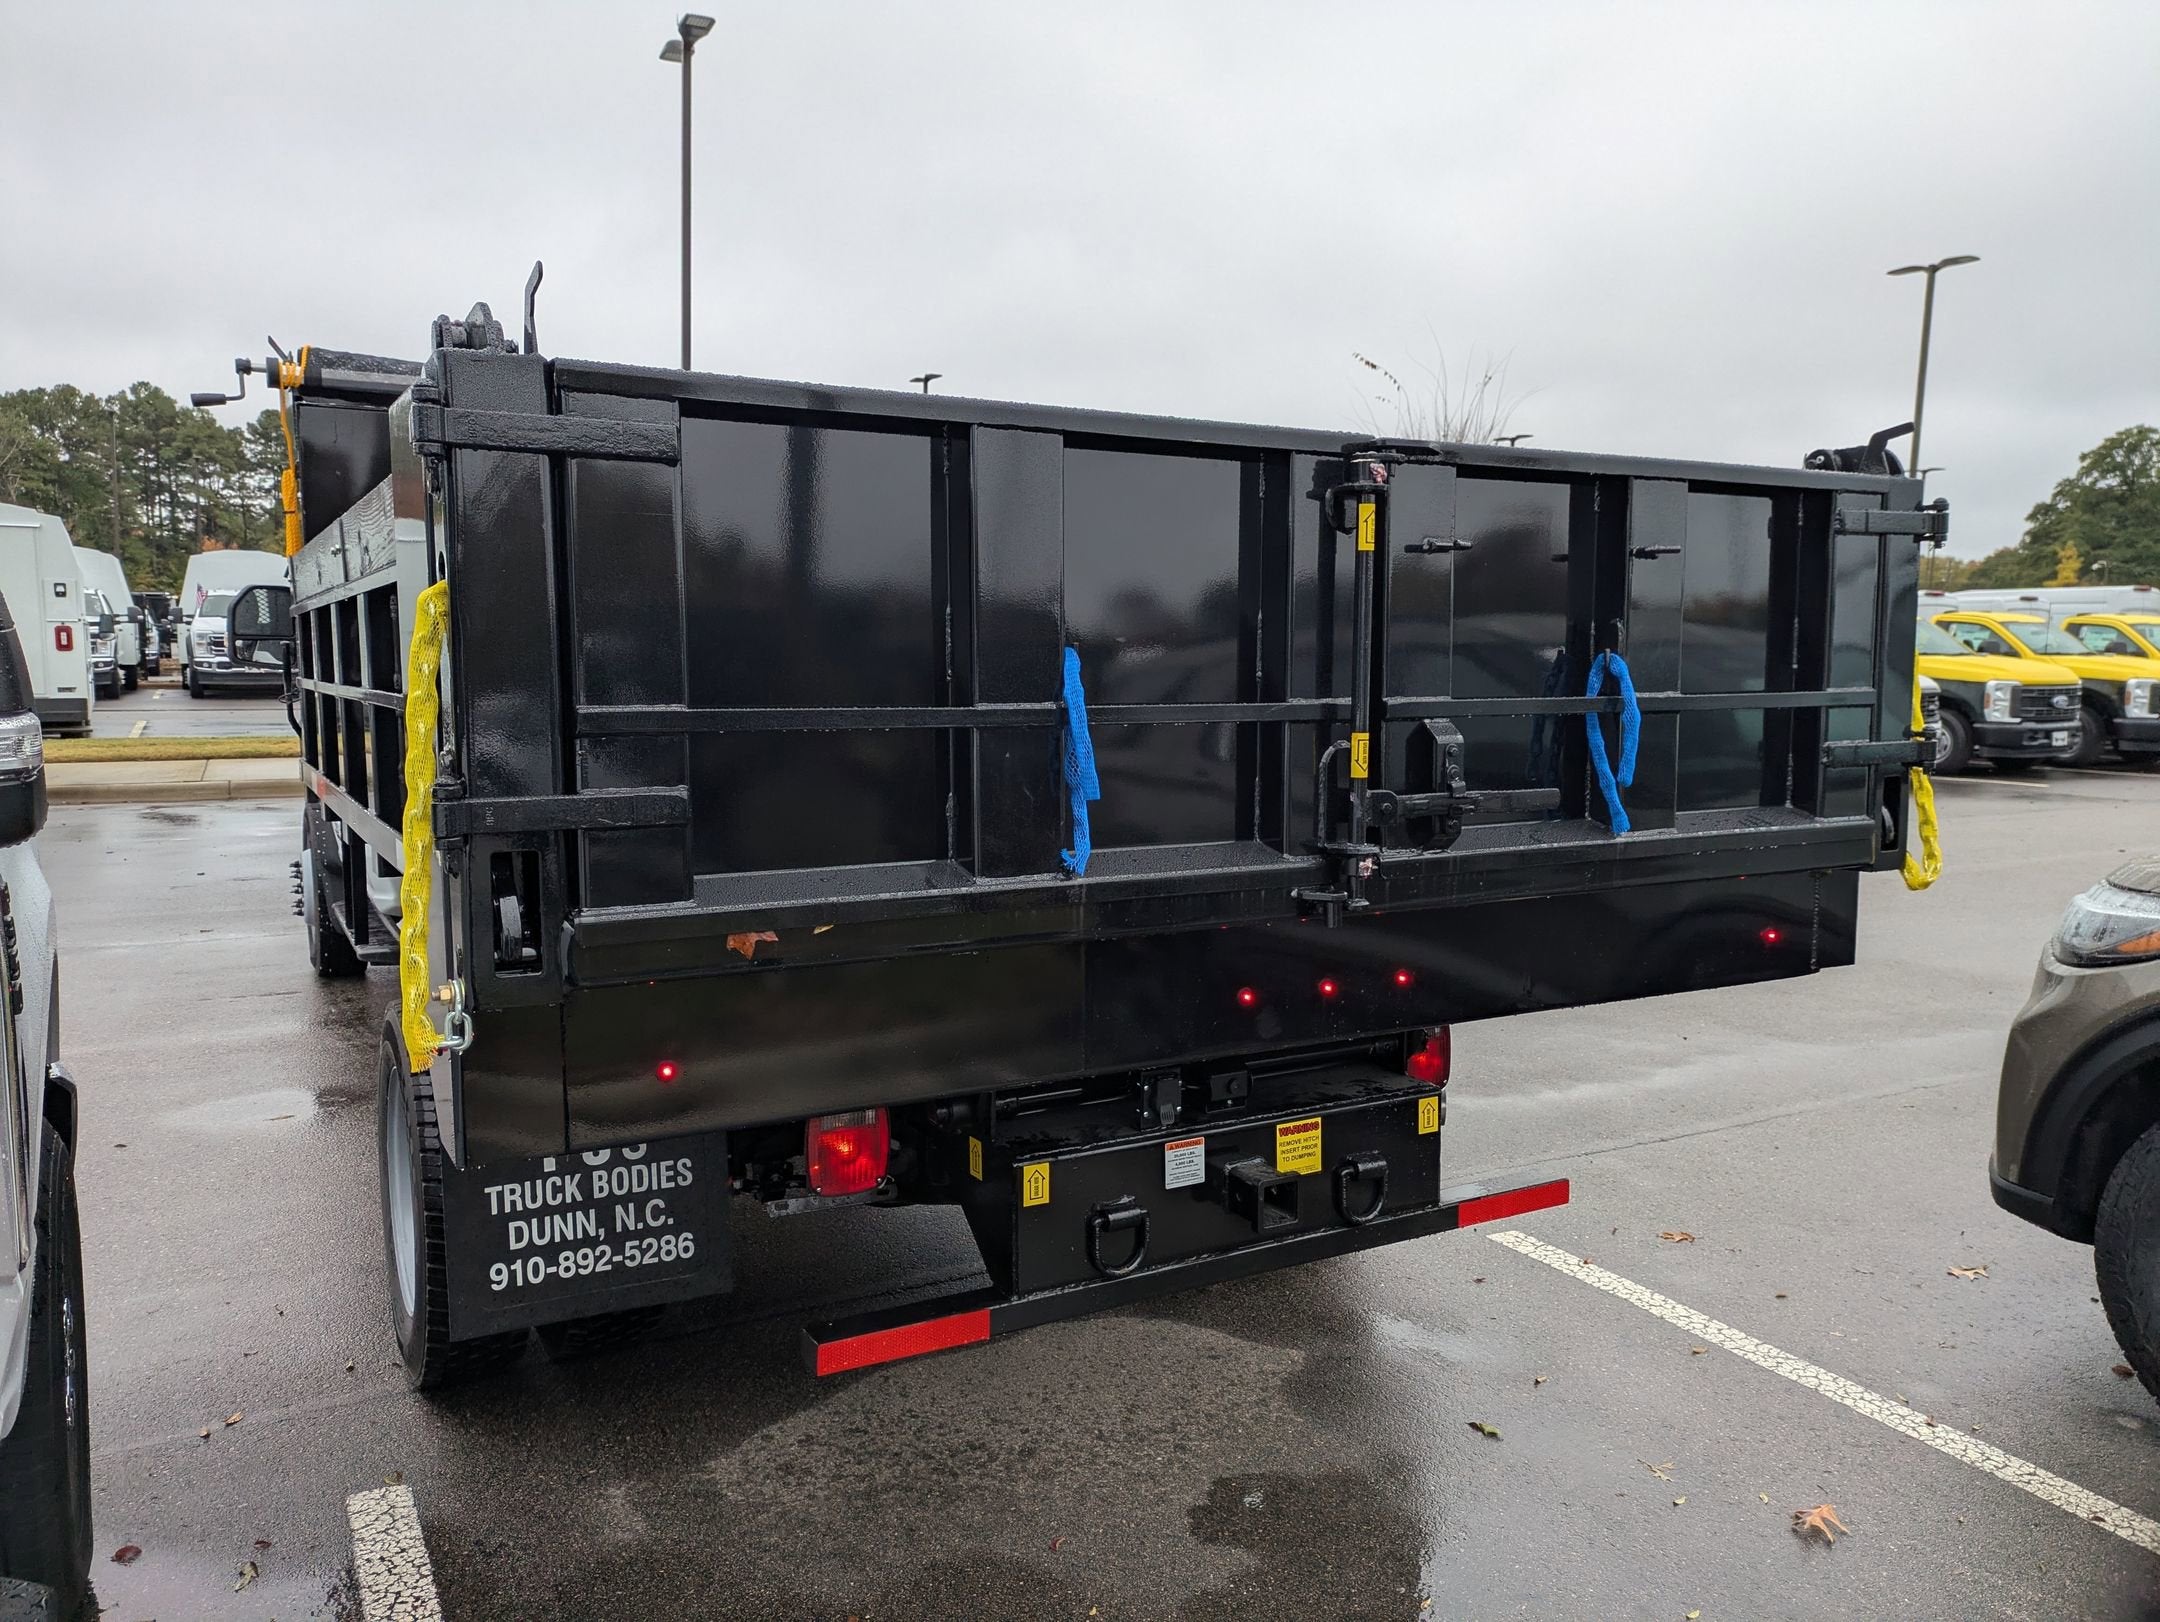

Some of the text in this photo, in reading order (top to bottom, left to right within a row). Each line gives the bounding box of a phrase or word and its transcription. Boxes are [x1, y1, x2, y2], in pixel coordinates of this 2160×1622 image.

[1278, 1121, 1319, 1137] WARNING
[1175, 1140, 1202, 1149] WARNING
[1279, 1135, 1319, 1147] REMOVE HITCH
[1281, 1143, 1318, 1155] INSERT PRIOR
[1291, 1151, 1316, 1160] DUMPING
[485, 1158, 693, 1215] TRUCK BODIES
[508, 1198, 674, 1250] DUNN, N.C.
[489, 1232, 695, 1290] 910-892-5286
